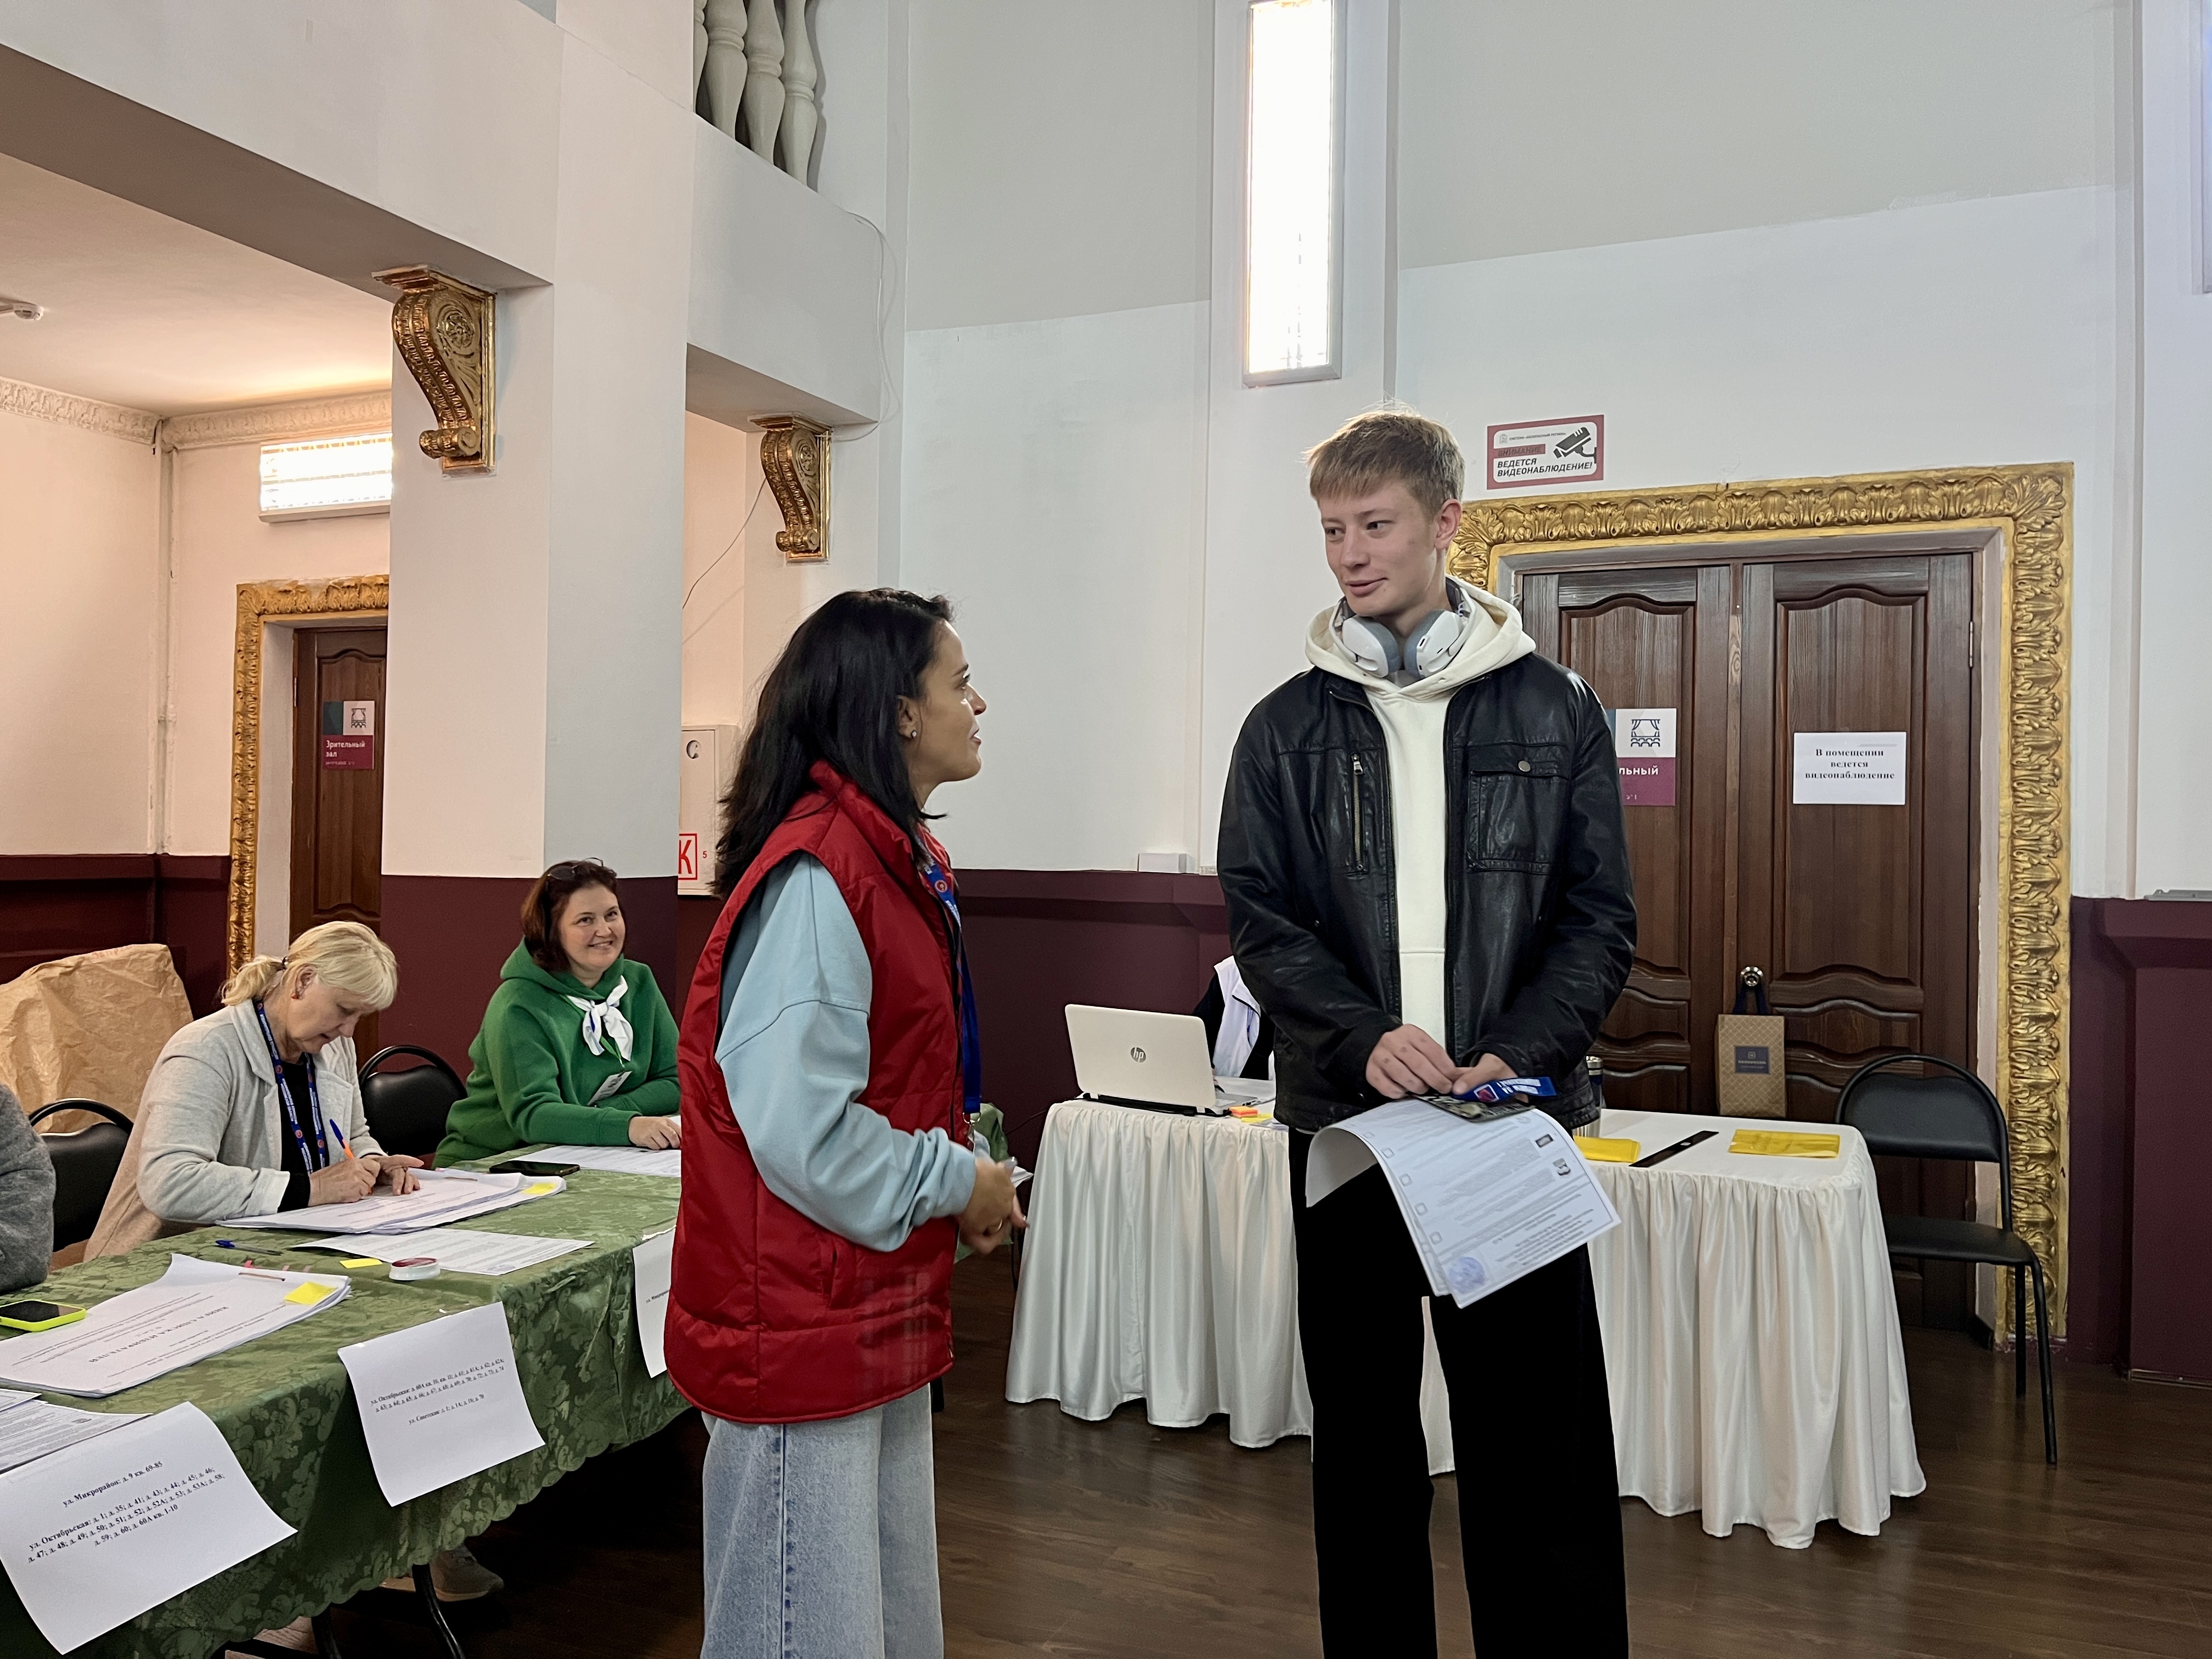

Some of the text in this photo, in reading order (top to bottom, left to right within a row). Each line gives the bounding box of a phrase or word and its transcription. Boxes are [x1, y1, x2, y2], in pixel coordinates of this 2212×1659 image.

[1498, 445, 1543, 457] ВНИМАНИЕ
[1497, 458, 1537, 469] ВЕДЕТСЯ
[1497, 462, 1593, 477] ВИДЕОНАБЛЮДЕНИЕ!
[326, 740, 365, 750] Зрительный
[1619, 765, 1658, 775] льный
[1805, 771, 1895, 780] видеонаблюдение
[678, 839, 692, 874] К
[1133, 1046, 1144, 1063] hp
[74, 1480, 121, 1501] Микрорайон:
[29, 1543, 41, 1551] ул.
[42, 1520, 92, 1544] Октябрьская:
